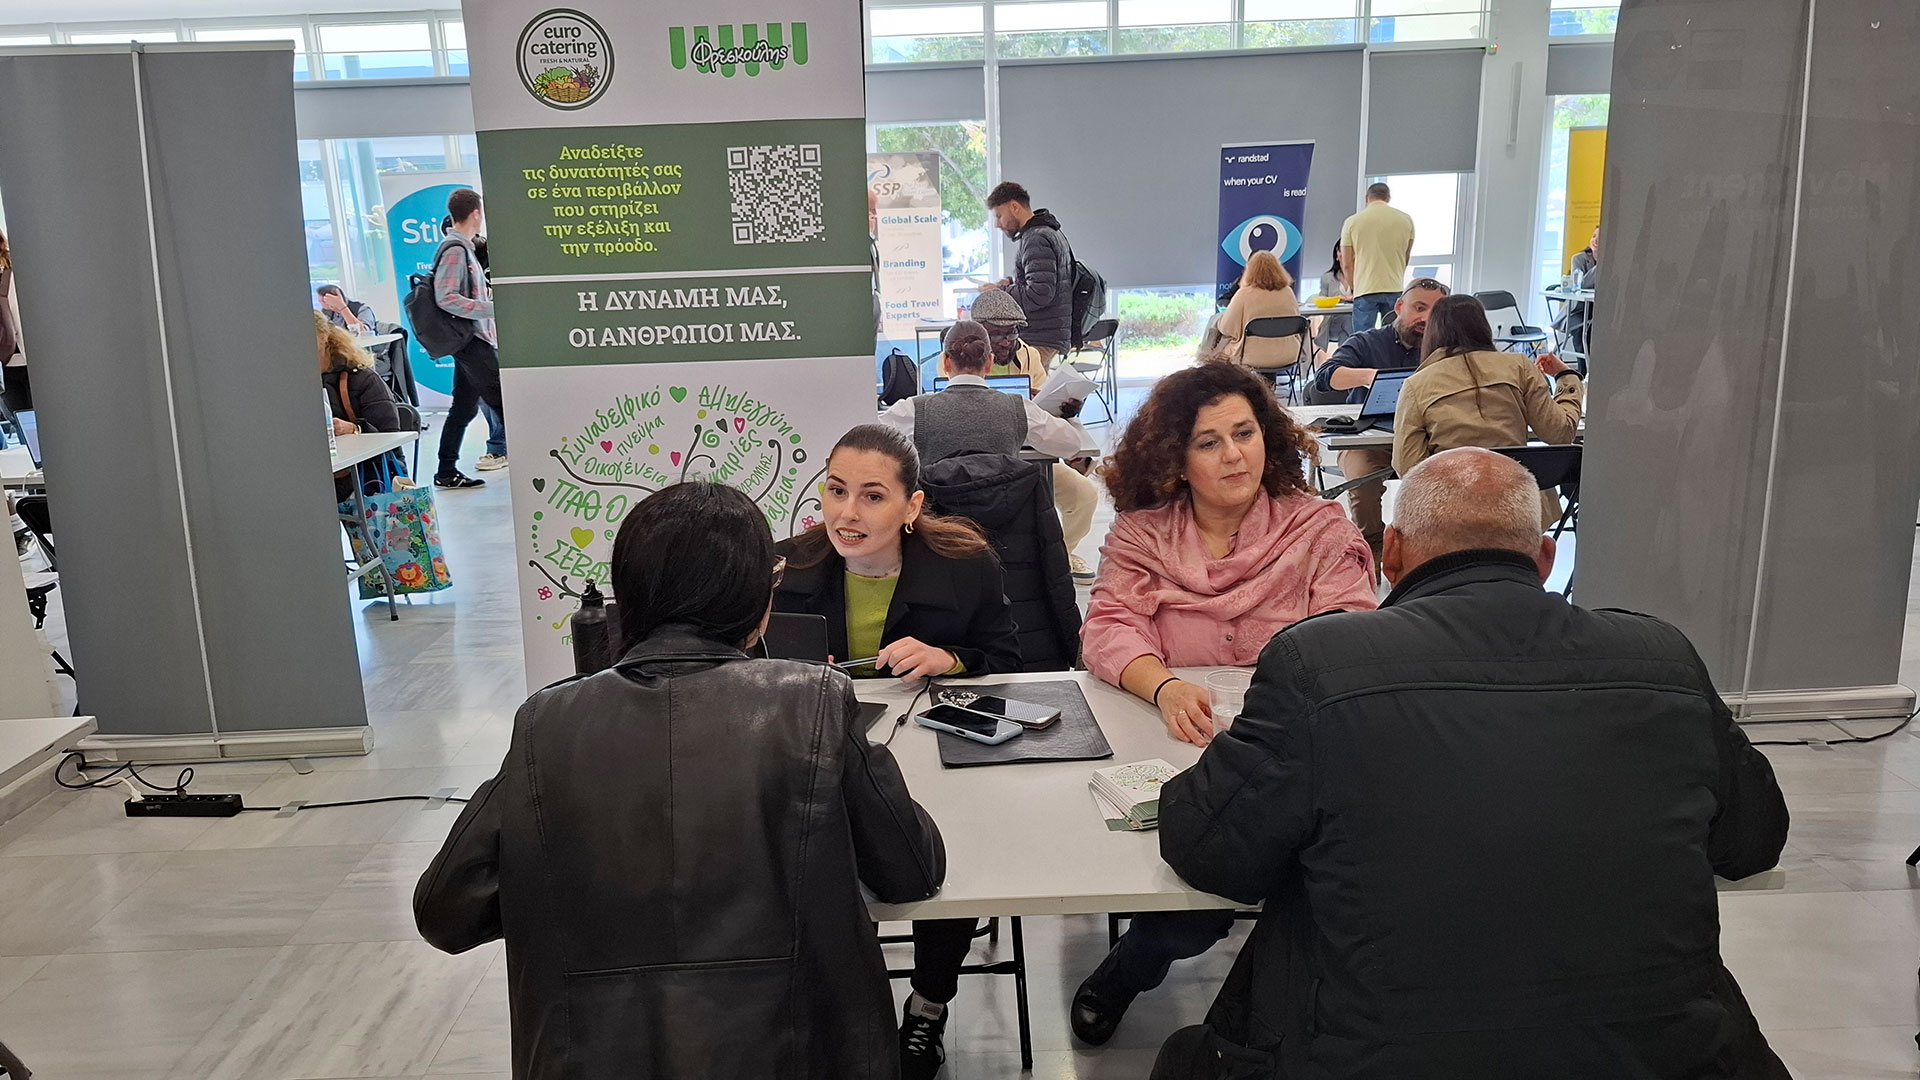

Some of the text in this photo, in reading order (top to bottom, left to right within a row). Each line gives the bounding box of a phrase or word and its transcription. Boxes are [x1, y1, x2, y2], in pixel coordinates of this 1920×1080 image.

[544, 26, 582, 39] euro
[530, 39, 597, 58] catering
[691, 35, 789, 73] Φρεσκούλης
[559, 144, 644, 161] Αναδείξτε
[1238, 153, 1270, 163] randstad
[522, 162, 682, 182] τις δυνατότητές σας
[1224, 175, 1278, 187] when your CV
[527, 181, 682, 200] σε ένα περιβάλλον
[872, 182, 901, 196] SSP
[1283, 187, 1307, 197] is read
[553, 200, 659, 219] που στηρίζει
[881, 214, 938, 225] Global Scale
[401, 217, 440, 244] Sti
[543, 220, 671, 239] την εξέλιξη και
[560, 238, 658, 257] την πρόοδο.
[883, 259, 926, 269] Branding
[577, 285, 788, 312] Η ΔΥΝΑΜΗ ΜΑΣ,
[885, 299, 940, 310] Food Travel
[886, 311, 921, 321] Experts
[568, 321, 802, 348] ΟΙ ΑΝΘΡΩΠΟΙ ΜΑΣ.
[561, 385, 661, 465] Συναδελφικό
[584, 457, 668, 487] Οικογένεια
[547, 478, 628, 523] ΠΑΘΟ
[543, 539, 613, 585] ΣΕΒΑΣ
